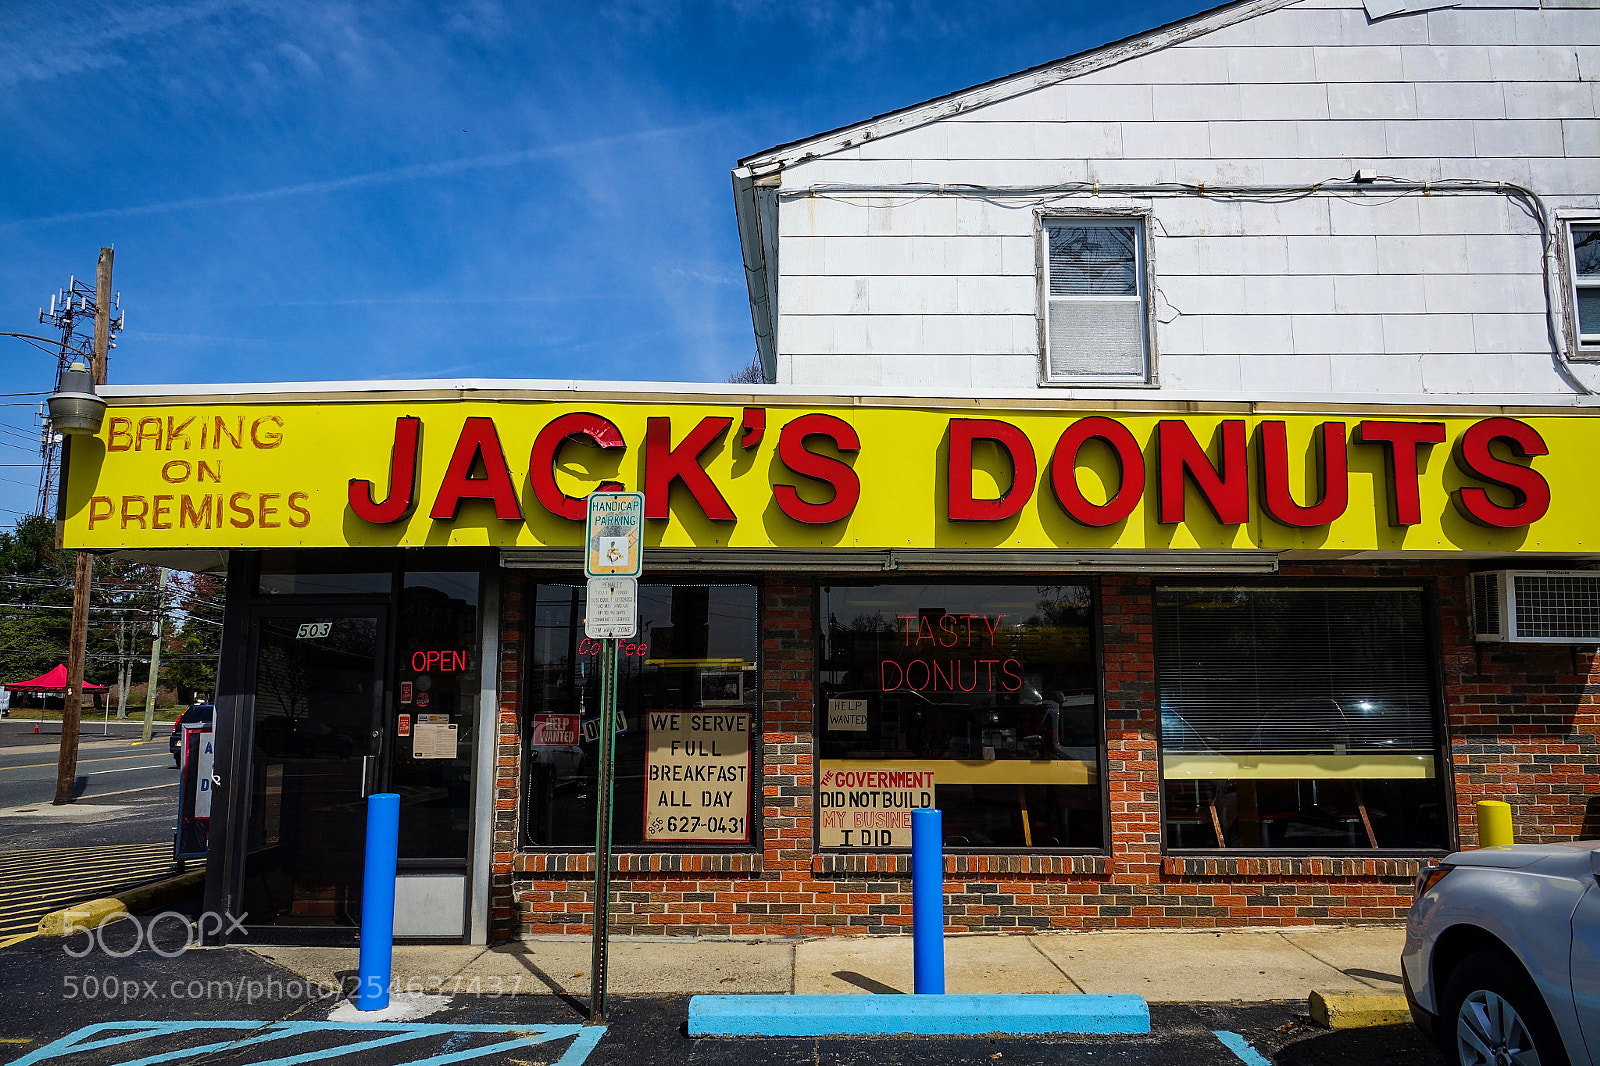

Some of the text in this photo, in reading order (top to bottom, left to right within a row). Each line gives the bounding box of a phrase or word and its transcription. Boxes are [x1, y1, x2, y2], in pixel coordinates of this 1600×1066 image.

[108, 415, 284, 452] BAKING
[161, 460, 223, 483] ON
[347, 406, 1551, 529] JACK'S DONUTS
[88, 491, 311, 531] PREMISES
[591, 501, 639, 512] HANDICAP
[594, 515, 636, 526] PARKING
[299, 623, 331, 638] 503
[897, 614, 1006, 647] TASTY
[578, 637, 648, 656] Cofee
[412, 650, 466, 671] OPEN
[881, 659, 1022, 691] DONUTS
[834, 701, 862, 711] HELP
[545, 717, 570, 731] HELP
[650, 714, 747, 731] WE SERVE
[830, 714, 868, 725] WANTED
[539, 730, 575, 743] WANTED
[671, 740, 722, 756] FULL
[649, 764, 747, 782] BREAKFAST
[820, 770, 934, 788] THE GOVERNMENT
[658, 790, 733, 808] ALL DAY
[820, 791, 931, 808] DID NOT BUILD
[668, 816, 744, 834] 627-0431
[822, 811, 912, 829] MY BUSINE
[839, 829, 892, 847] I DID
